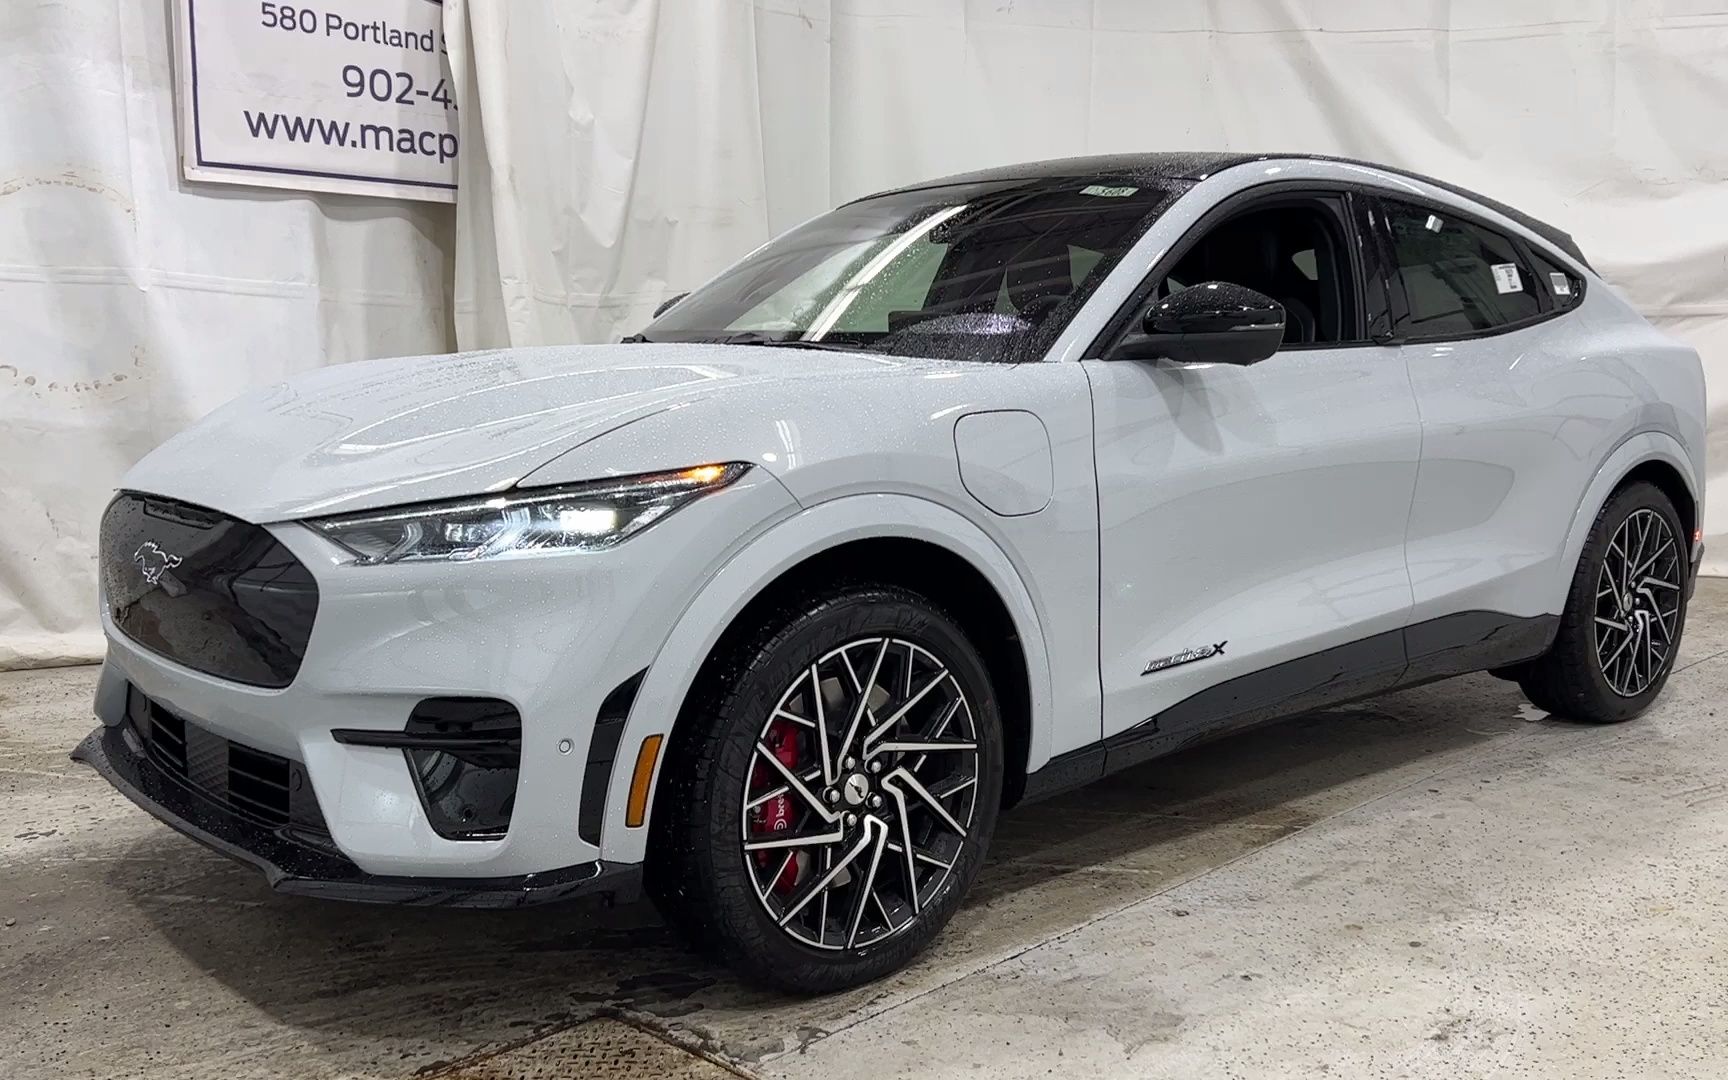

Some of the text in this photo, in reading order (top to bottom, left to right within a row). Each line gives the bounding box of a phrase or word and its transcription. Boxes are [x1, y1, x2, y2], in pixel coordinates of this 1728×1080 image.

[261, 2, 317, 34] 580
[325, 13, 434, 53] Portland
[342, 64, 458, 111] 902-4
[243, 110, 458, 163] www.macp
